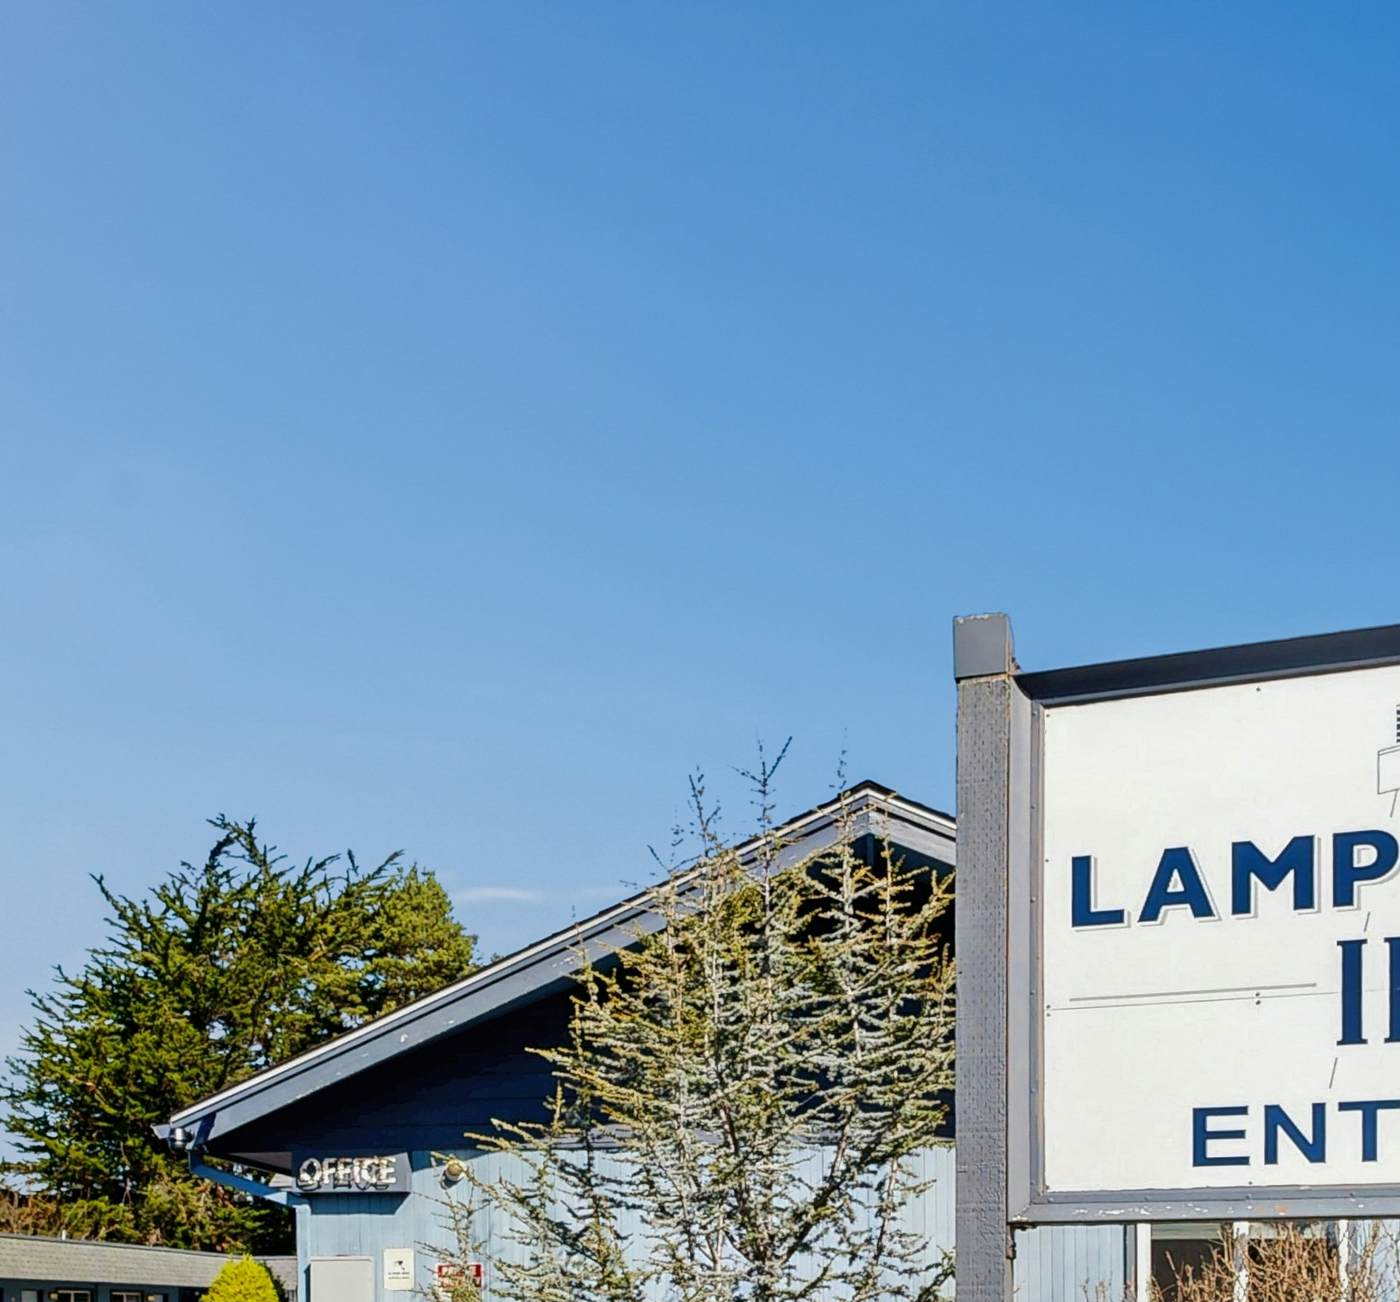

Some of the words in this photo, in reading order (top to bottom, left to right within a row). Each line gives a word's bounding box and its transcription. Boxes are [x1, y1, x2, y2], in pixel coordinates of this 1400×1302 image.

[1071, 829, 1400, 929] LAMP
[1336, 936, 1400, 1046] I
[299, 1157, 396, 1186] OFFICE
[1192, 1100, 1400, 1167] ENT
